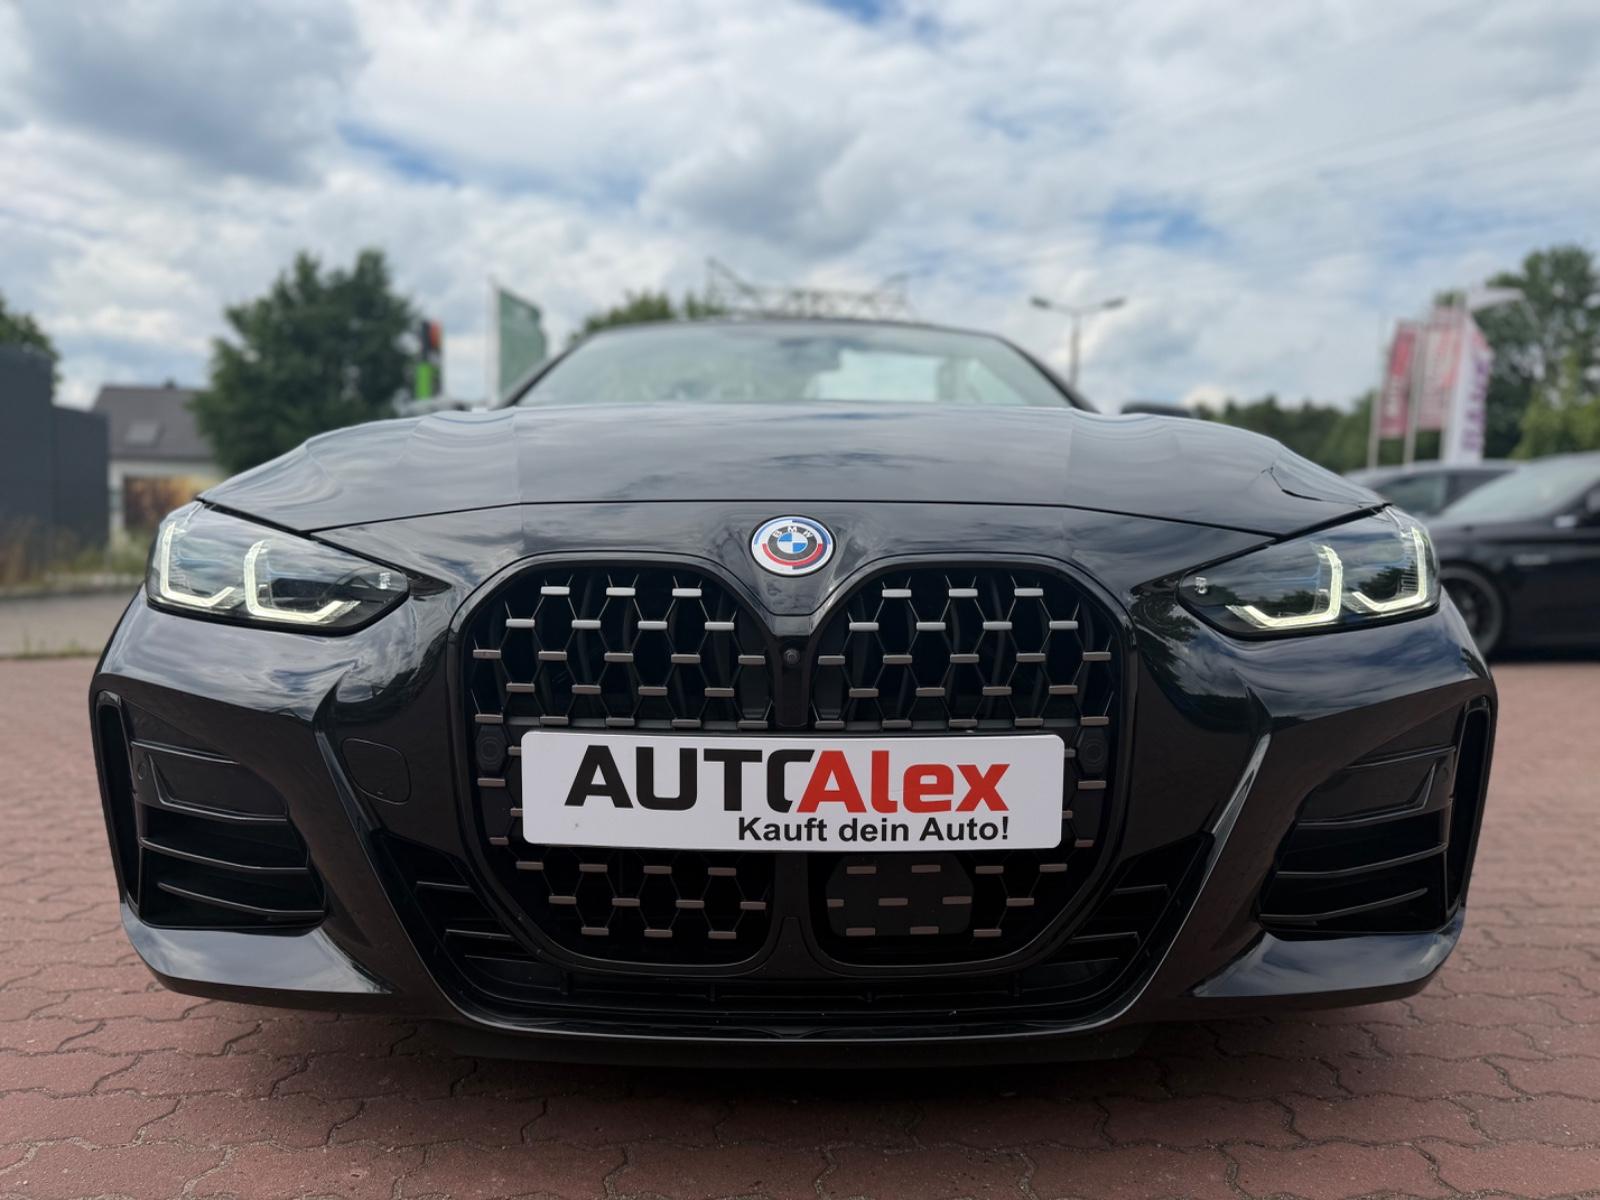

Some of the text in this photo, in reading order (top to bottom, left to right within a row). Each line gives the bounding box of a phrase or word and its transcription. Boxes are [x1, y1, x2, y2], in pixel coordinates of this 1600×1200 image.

[772, 525, 814, 538] BMW
[739, 816, 1009, 842] Kauft dein Auto!
